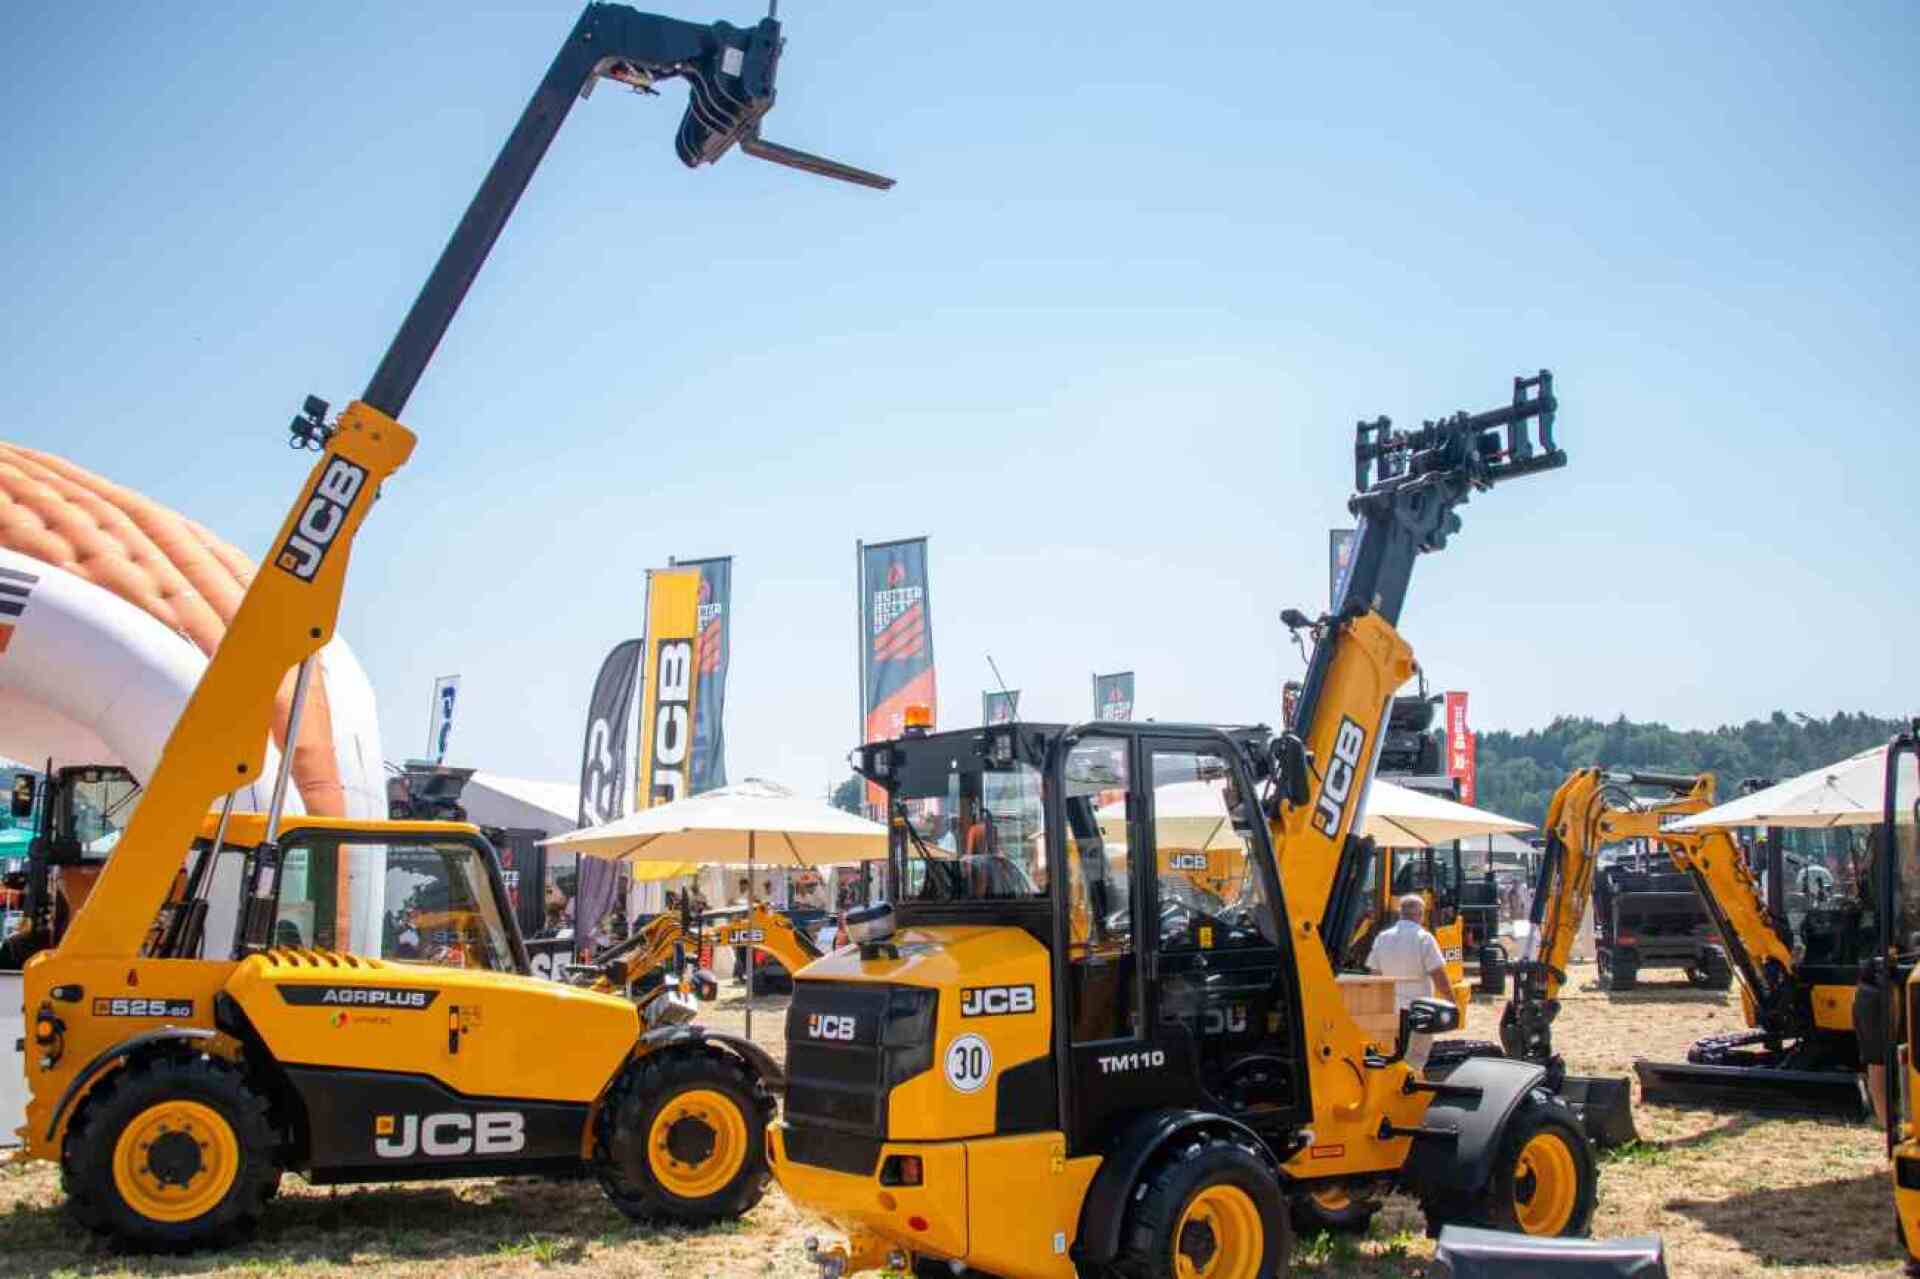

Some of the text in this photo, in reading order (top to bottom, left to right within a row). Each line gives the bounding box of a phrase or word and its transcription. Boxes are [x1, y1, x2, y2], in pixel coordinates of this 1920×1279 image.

[284, 459, 364, 578] JCB
[655, 641, 692, 802] JCB
[1317, 719, 1364, 837] JCB
[1171, 854, 1206, 869] JCB
[730, 930, 763, 942] JCB
[962, 986, 1034, 1015] JCB
[809, 1015, 855, 1040] JCB
[955, 1046, 982, 1079] 30
[1098, 1050, 1165, 1073] TM110
[375, 1112, 525, 1157] JCB
